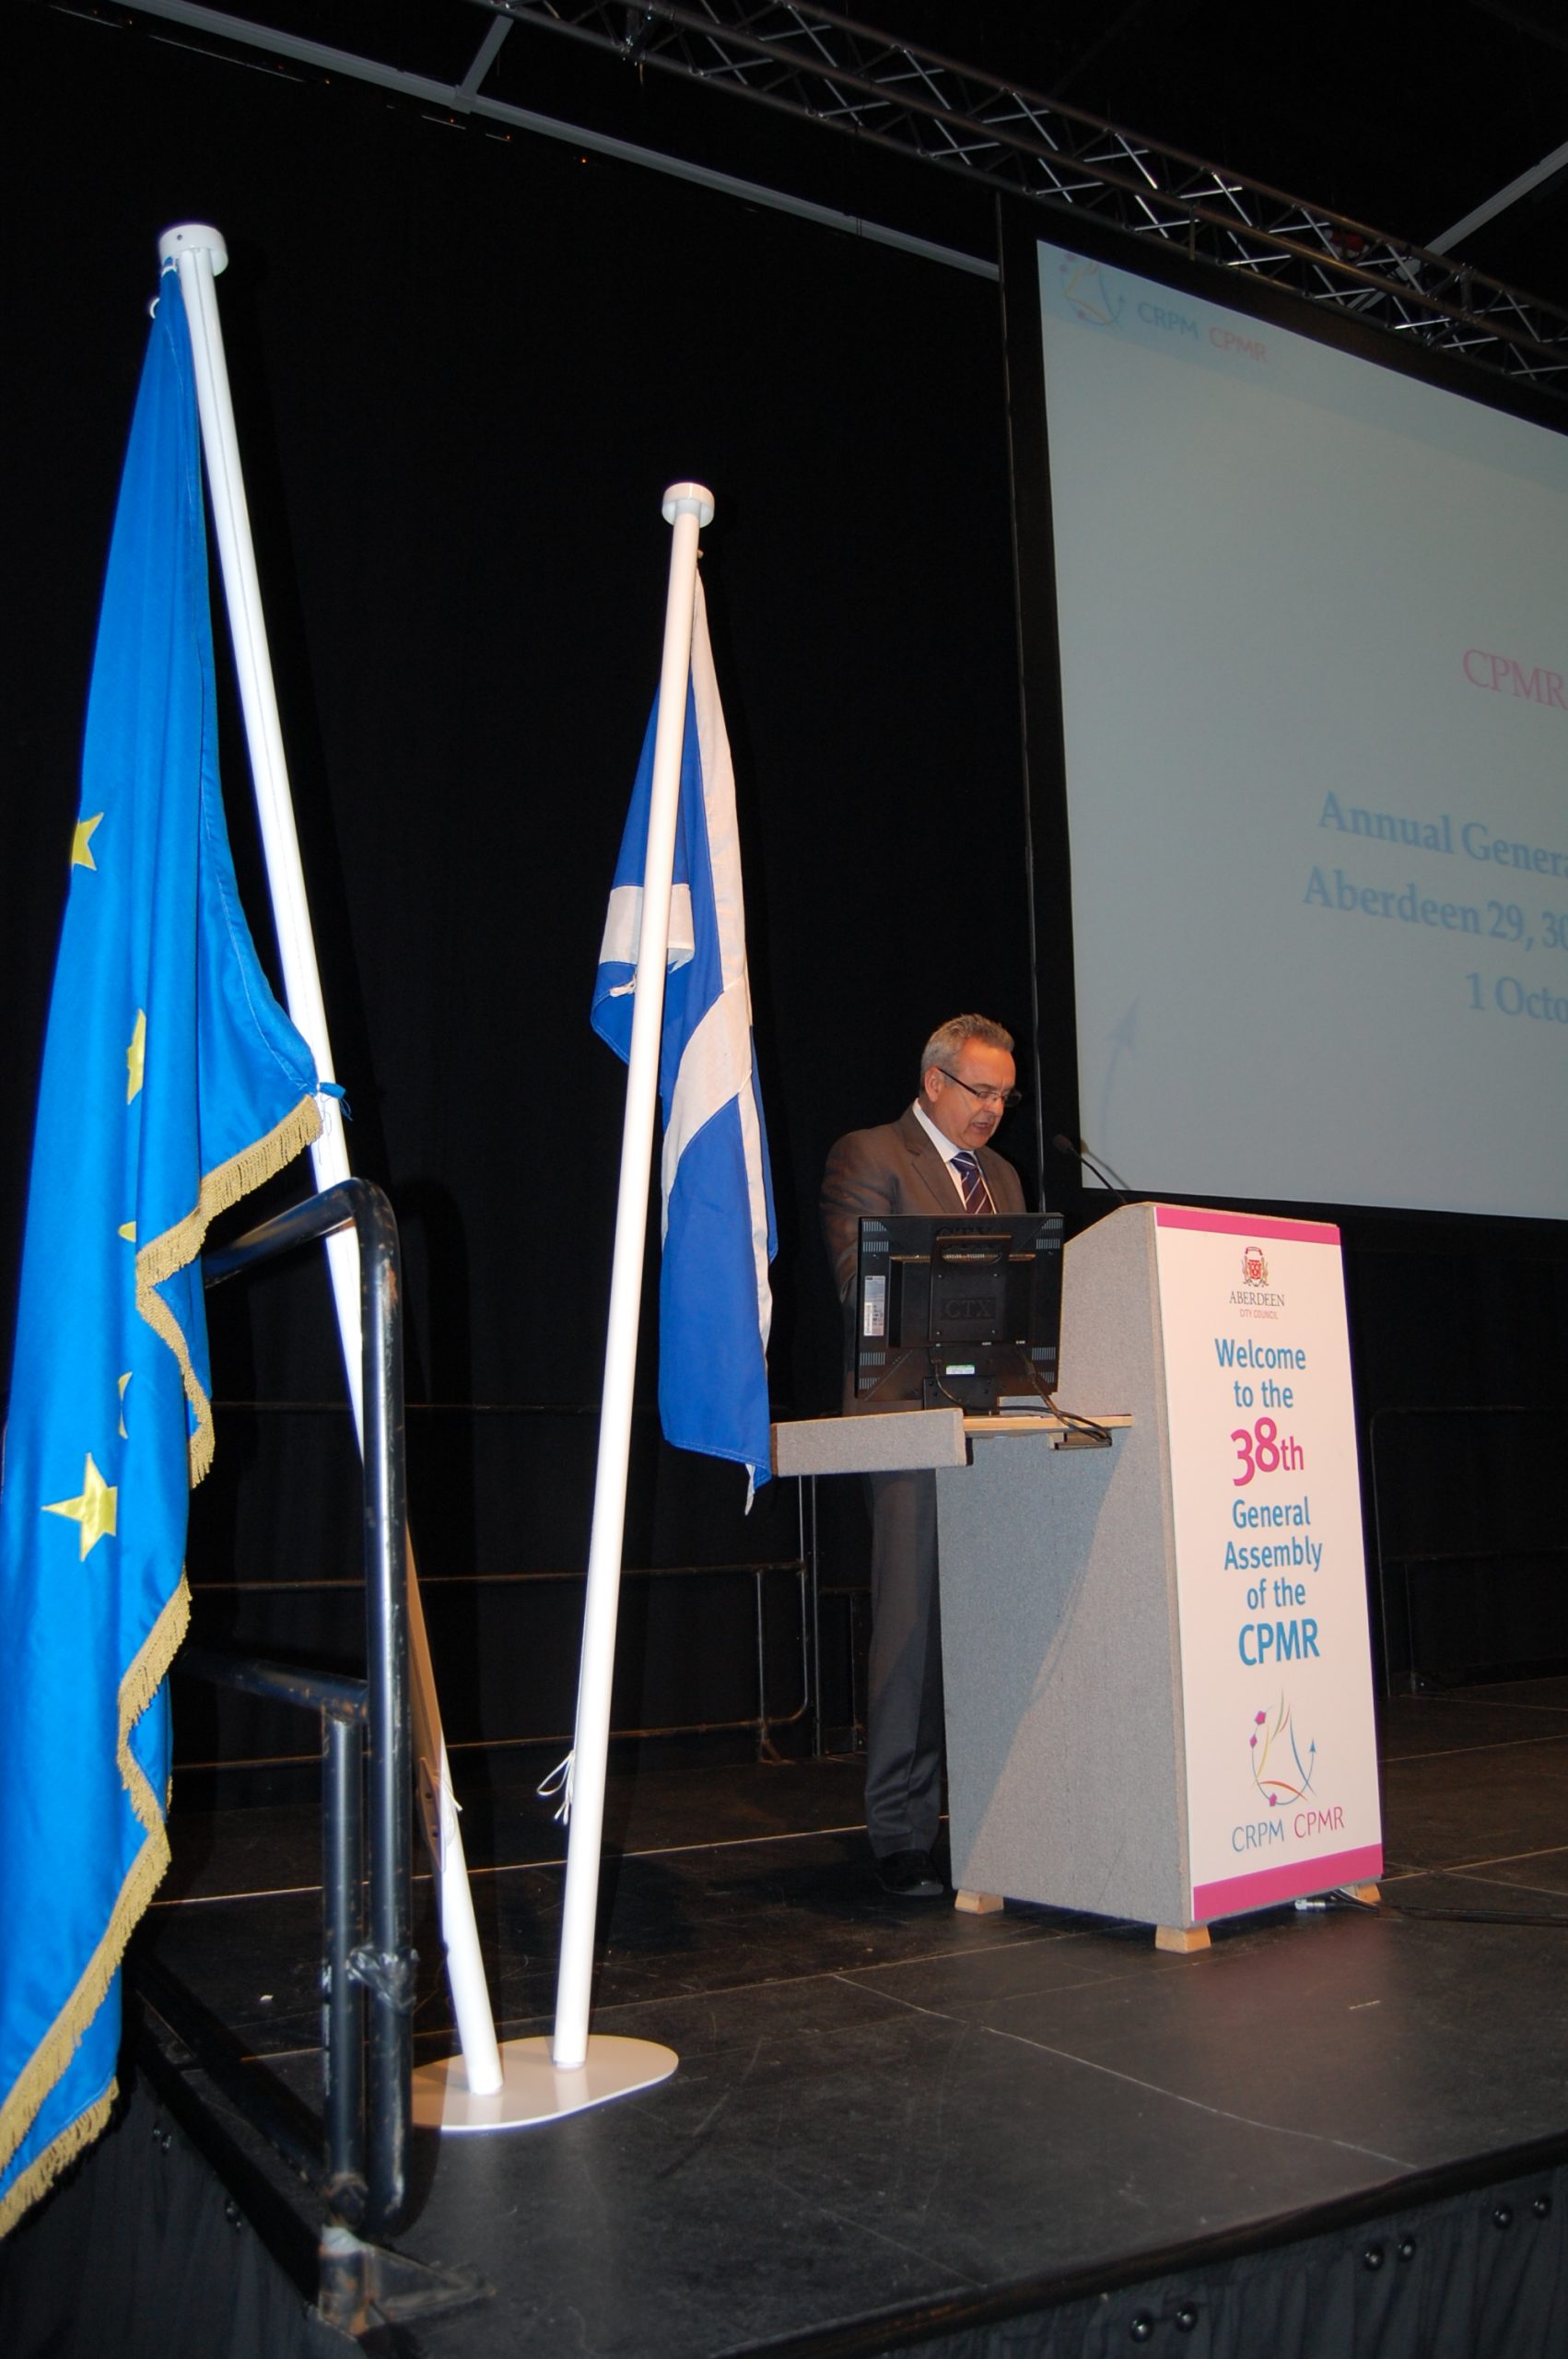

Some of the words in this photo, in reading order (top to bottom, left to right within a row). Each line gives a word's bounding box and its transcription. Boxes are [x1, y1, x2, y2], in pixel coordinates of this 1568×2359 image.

[1137, 301, 1199, 340] CRPM
[1208, 325, 1269, 363] CPMR
[1462, 649, 1568, 710] CPMR
[1317, 790, 1455, 856] Annual
[1302, 864, 1481, 936] Aberdeen
[1486, 899, 1535, 952] 29,
[1465, 972, 1485, 1011] 1
[945, 1299, 993, 1319] CTX
[1229, 1291, 1285, 1307] ABERDEEN
[1214, 1338, 1306, 1370] Welcome
[1234, 1380, 1254, 1408] to
[1261, 1379, 1293, 1408] the
[1230, 1416, 1305, 1486] 38th
[1233, 1496, 1311, 1529] General
[1223, 1535, 1323, 1573] Assembly
[1246, 1578, 1267, 1610] of
[1273, 1577, 1306, 1608] the
[1238, 1618, 1320, 1666] CPMR
[1232, 1818, 1285, 1852] CRPM
[1293, 1806, 1345, 1838] CPMR
